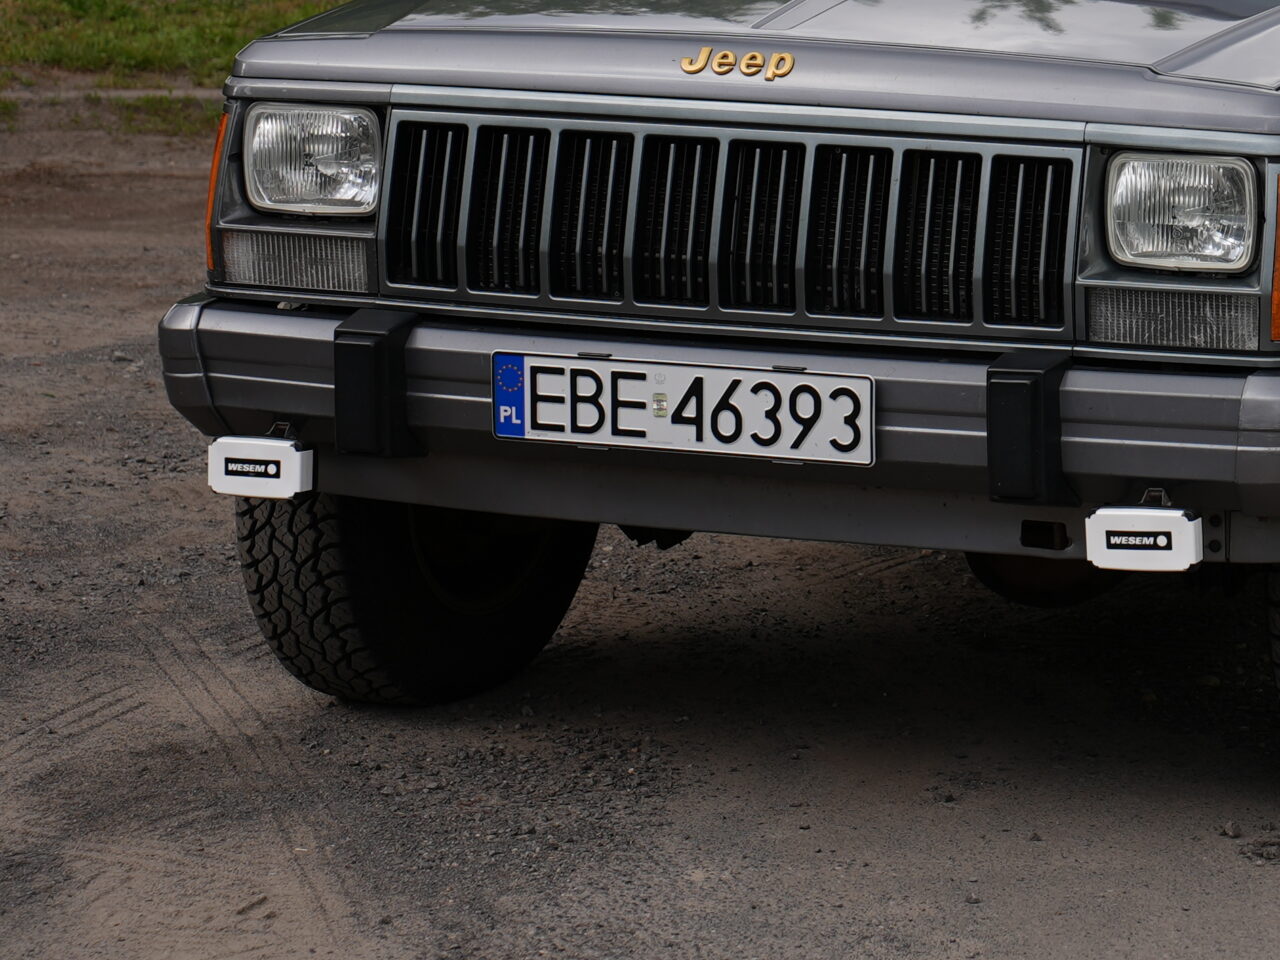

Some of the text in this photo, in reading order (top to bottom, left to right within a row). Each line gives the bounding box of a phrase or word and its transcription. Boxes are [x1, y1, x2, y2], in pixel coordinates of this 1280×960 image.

[680, 46, 795, 82] Jeep
[499, 405, 522, 425] PL
[529, 365, 862, 453] EBE 46393
[227, 462, 266, 473] WESEM
[1109, 535, 1155, 546] WESEM
